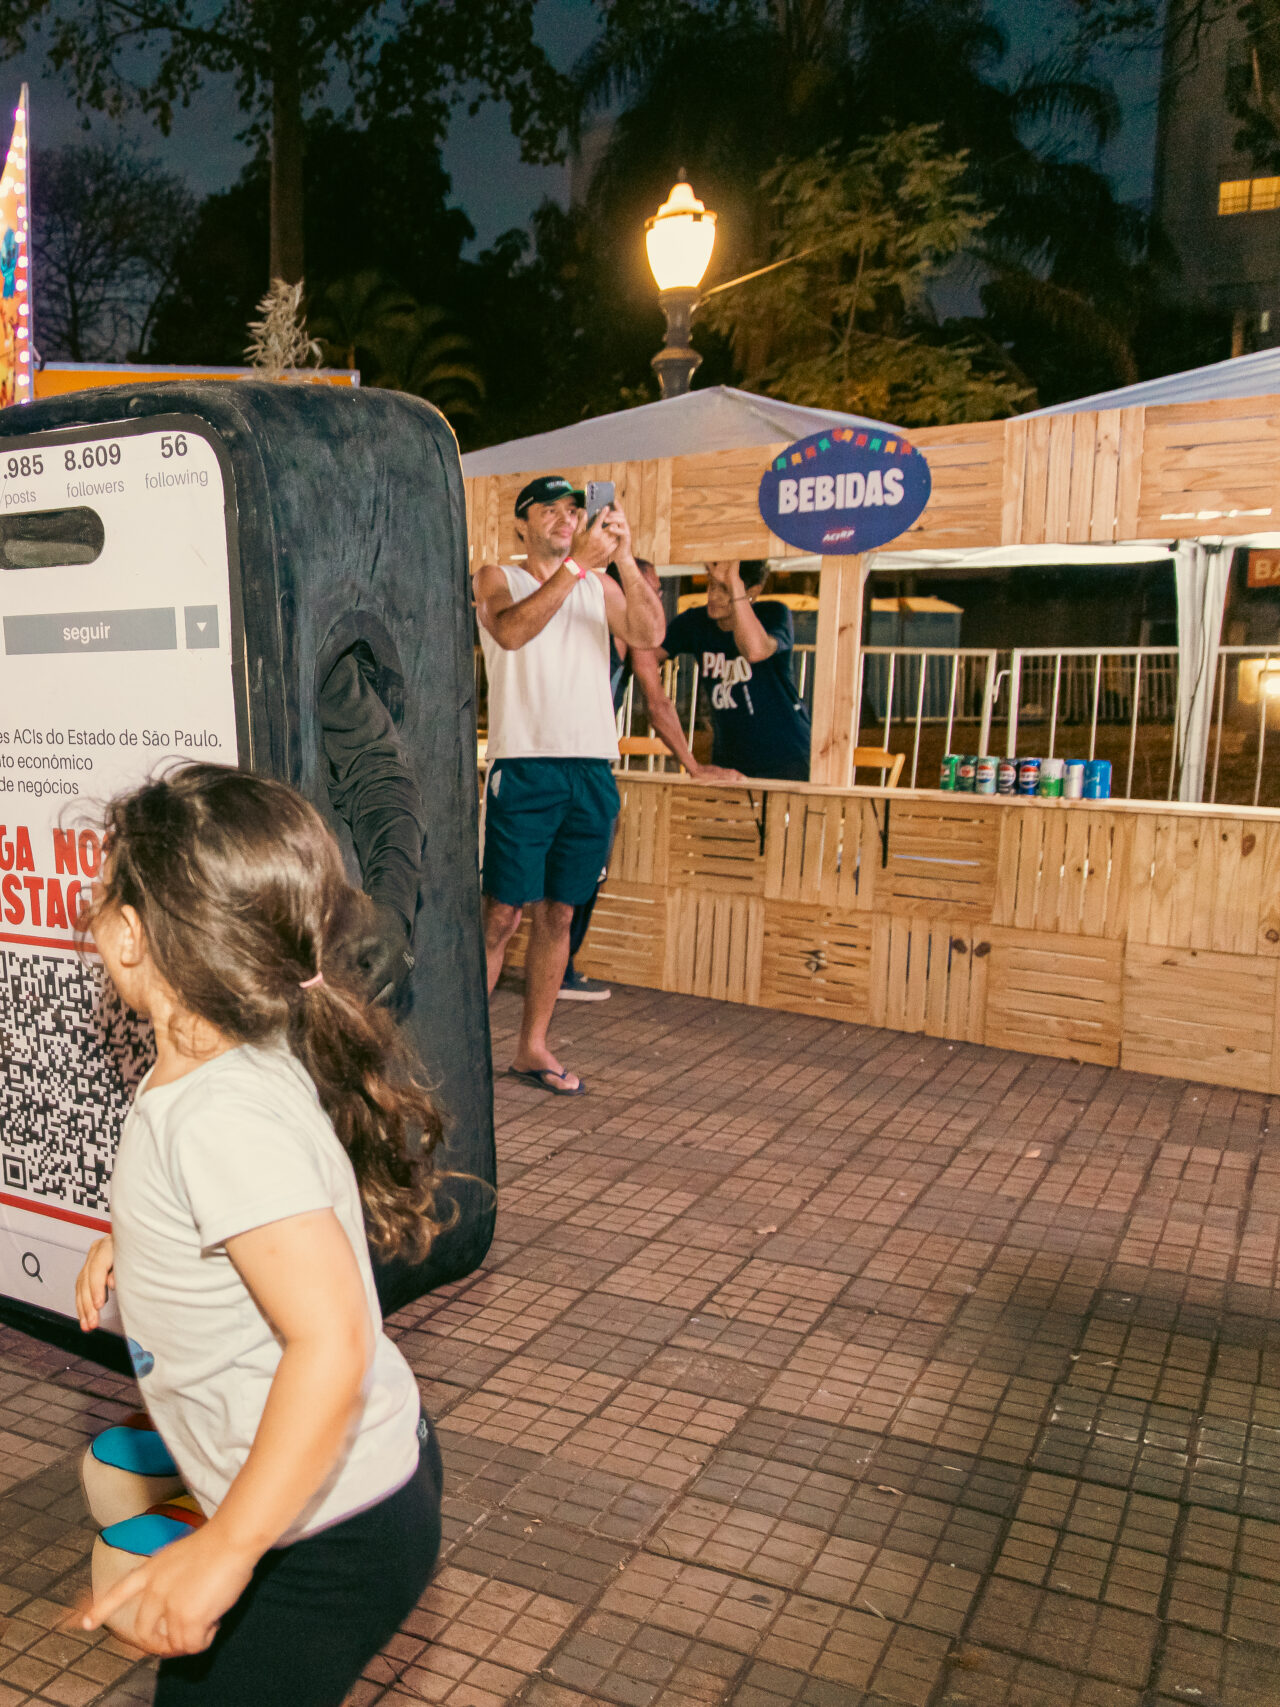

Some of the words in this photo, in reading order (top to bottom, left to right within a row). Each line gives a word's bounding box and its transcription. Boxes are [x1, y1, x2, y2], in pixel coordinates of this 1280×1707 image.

[64, 443, 121, 471] 8.609
[160, 434, 188, 459] 56
[4, 489, 37, 508] posts
[66, 479, 125, 498] followers
[145, 469, 209, 489] following
[778, 467, 905, 514] BEBIDAS
[822, 529, 856, 543] ACIRP
[63, 622, 111, 644] seguir
[13, 729, 43, 745] ACIs
[46, 728, 64, 745] do
[68, 729, 116, 746] Estado
[119, 729, 138, 746] de
[142, 730, 170, 746] São
[174, 730, 222, 747] Paulo.
[17, 753, 93, 770] econômico
[17, 778, 80, 797] negócios
